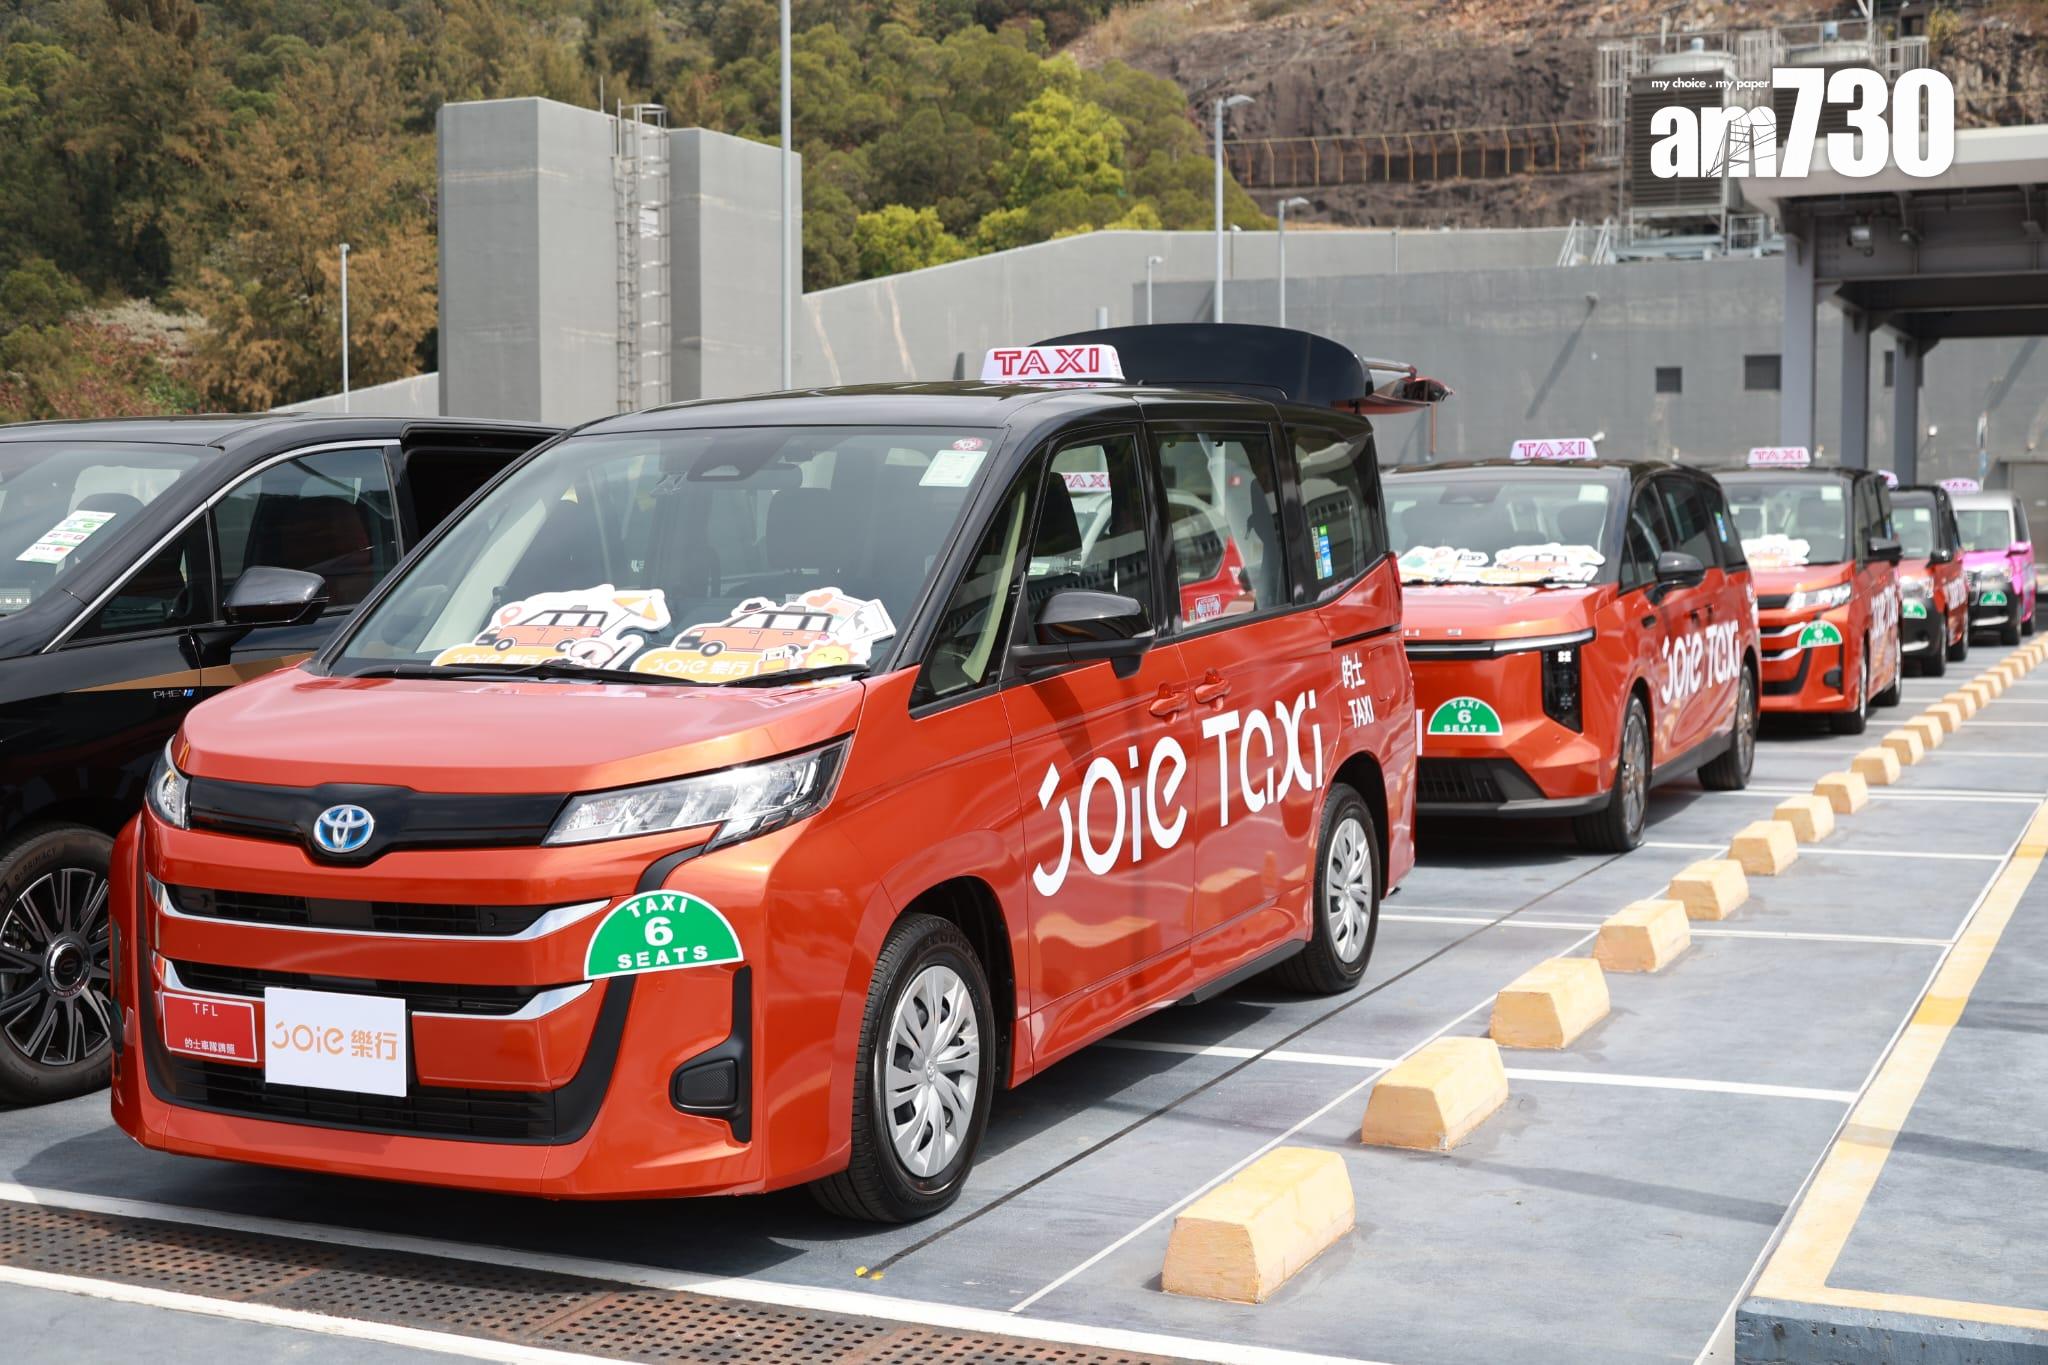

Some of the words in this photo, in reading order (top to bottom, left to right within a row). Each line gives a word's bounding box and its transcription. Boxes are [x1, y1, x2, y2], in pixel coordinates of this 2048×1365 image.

[993, 347, 1099, 376] TAXI
[1519, 441, 1585, 458] TAXI
[1754, 449, 1803, 461] TAXI
[1341, 651, 1366, 689] 的士
[1348, 695, 1375, 729] TAXI
[1450, 700, 1480, 710] TAXI
[1457, 709, 1472, 724] 6
[1443, 724, 1487, 733] SEATS
[626, 895, 688, 918] TAXI
[644, 916, 674, 946] 6
[617, 945, 709, 969] SEATS
[192, 1002, 218, 1017] TFL
[351, 1029, 398, 1061] 樂行
